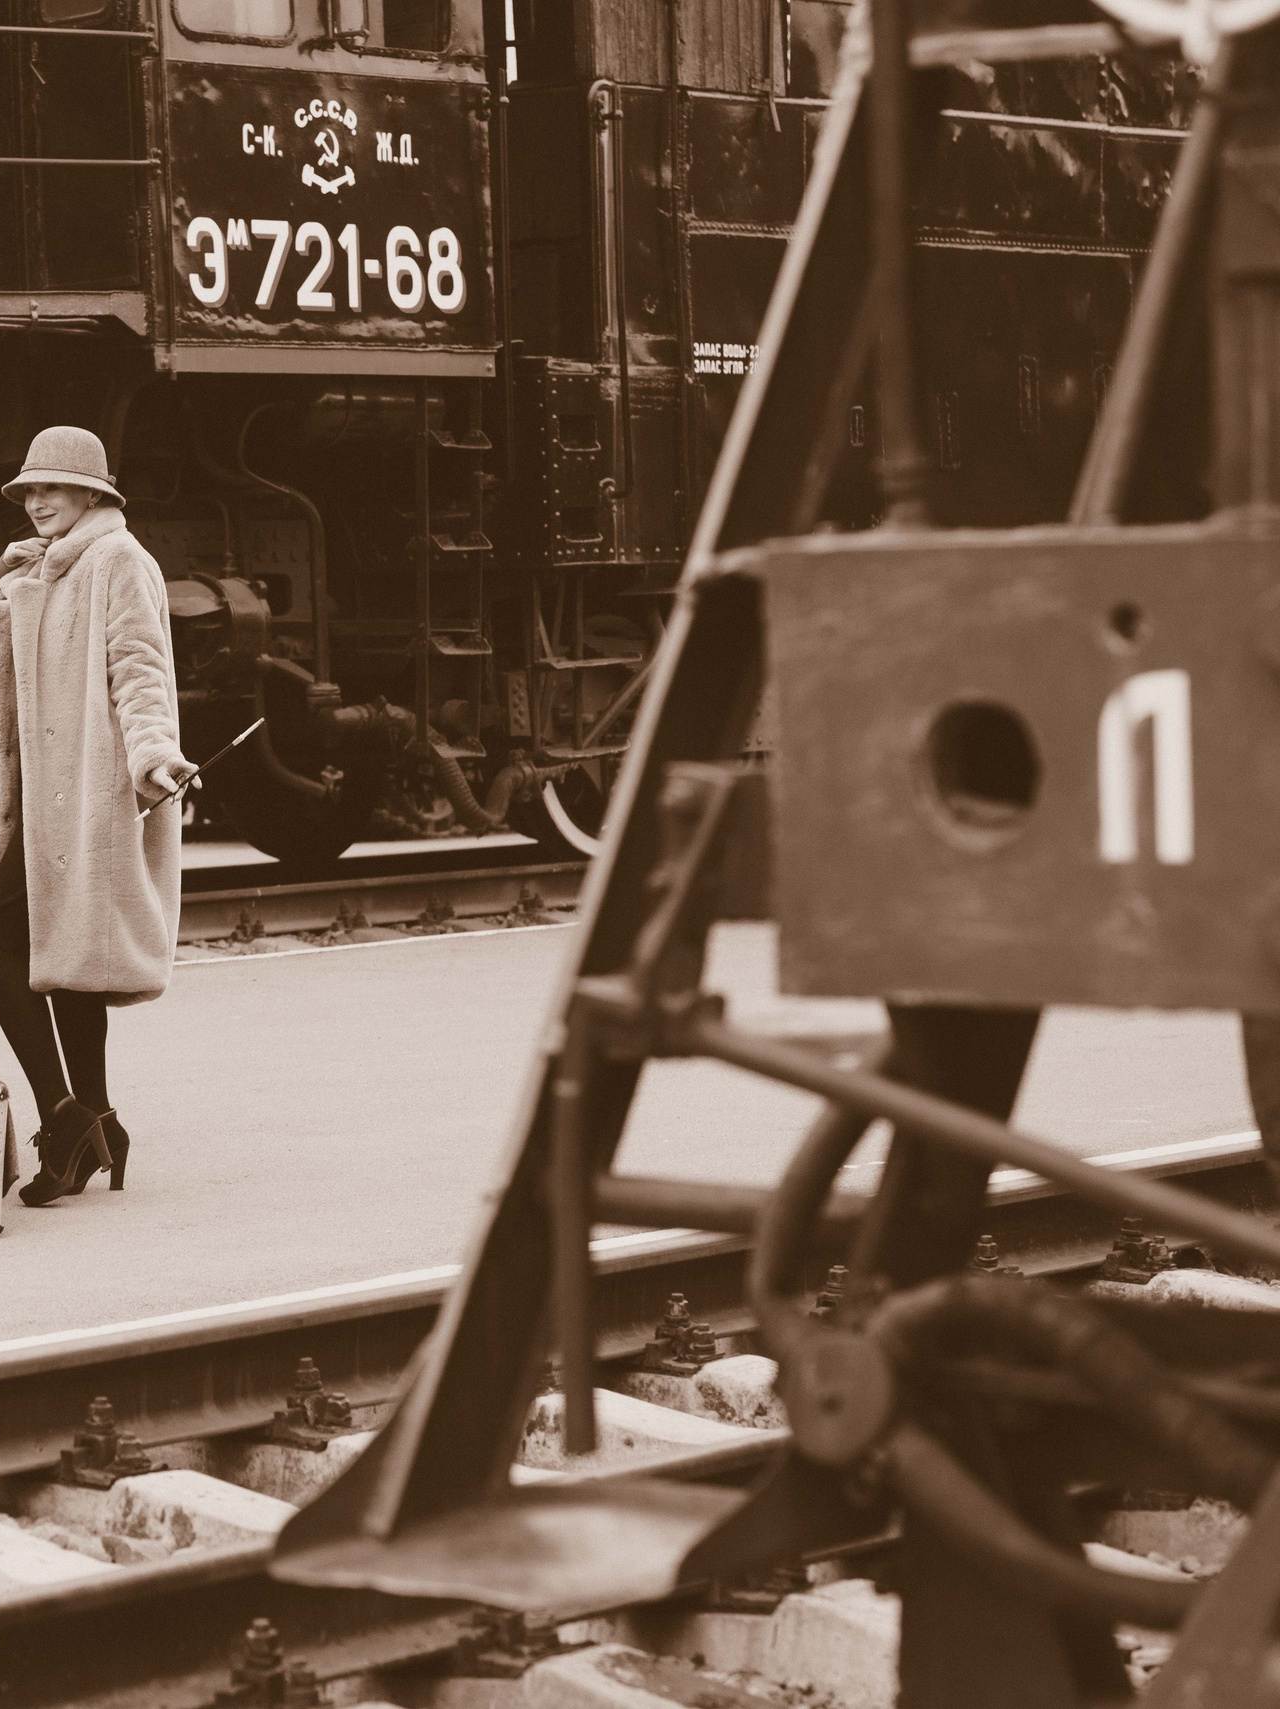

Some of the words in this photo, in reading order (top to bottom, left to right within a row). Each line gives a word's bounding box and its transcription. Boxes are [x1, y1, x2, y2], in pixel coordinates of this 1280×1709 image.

[376, 131, 420, 165] Ж.Д.
[693, 342, 722, 357] ЗАПАС
[694, 359, 722, 374] ЗАПАС
